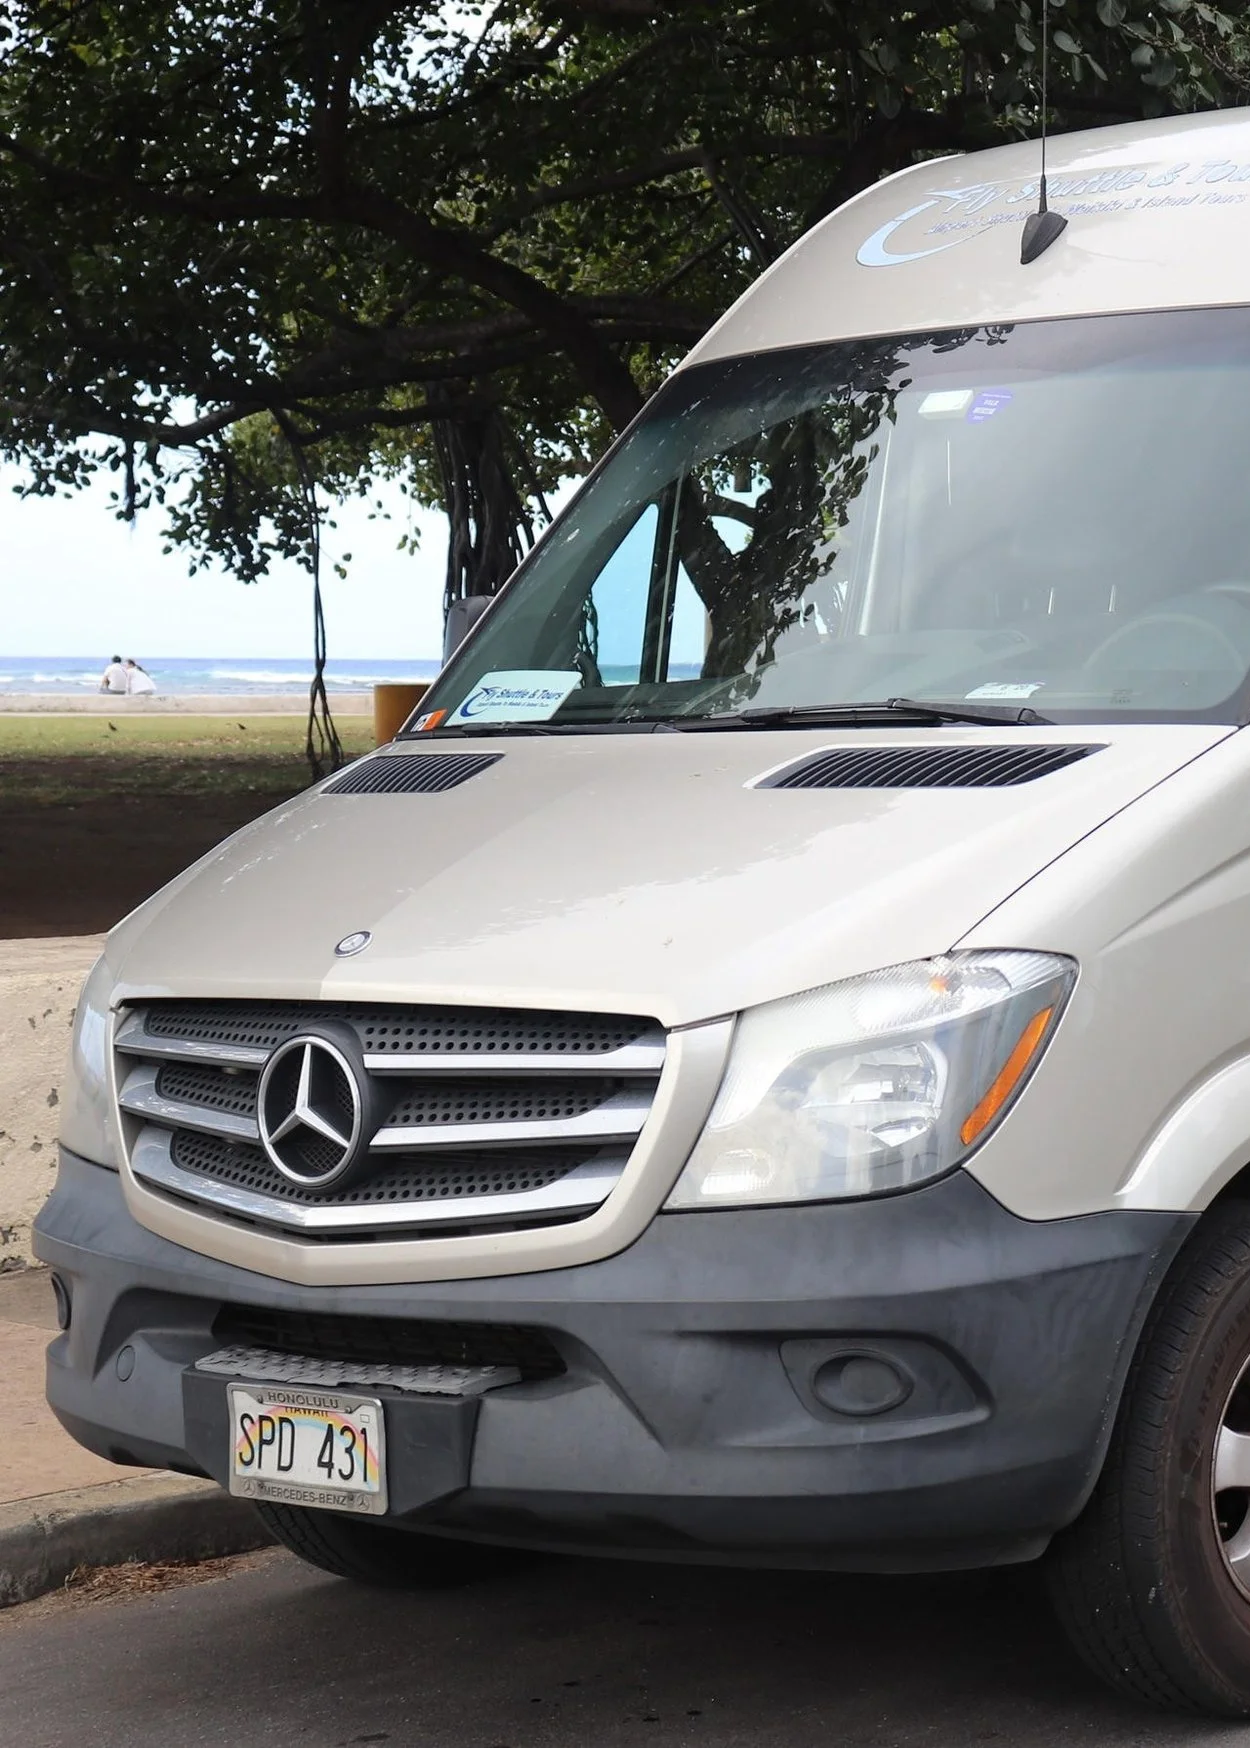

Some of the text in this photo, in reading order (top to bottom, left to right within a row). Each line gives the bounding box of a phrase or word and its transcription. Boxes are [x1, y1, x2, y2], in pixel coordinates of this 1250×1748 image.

[943, 185, 1010, 216] Fly
[1006, 168, 1147, 204] Shuttle
[1147, 161, 1191, 188] &
[497, 688, 530, 699] Shuttle
[537, 690, 564, 700] Tours
[267, 1391, 339, 1409] HONOLULU
[239, 1413, 368, 1482] SPD 431
[264, 1485, 347, 1506] MERCEDES-BENZ
